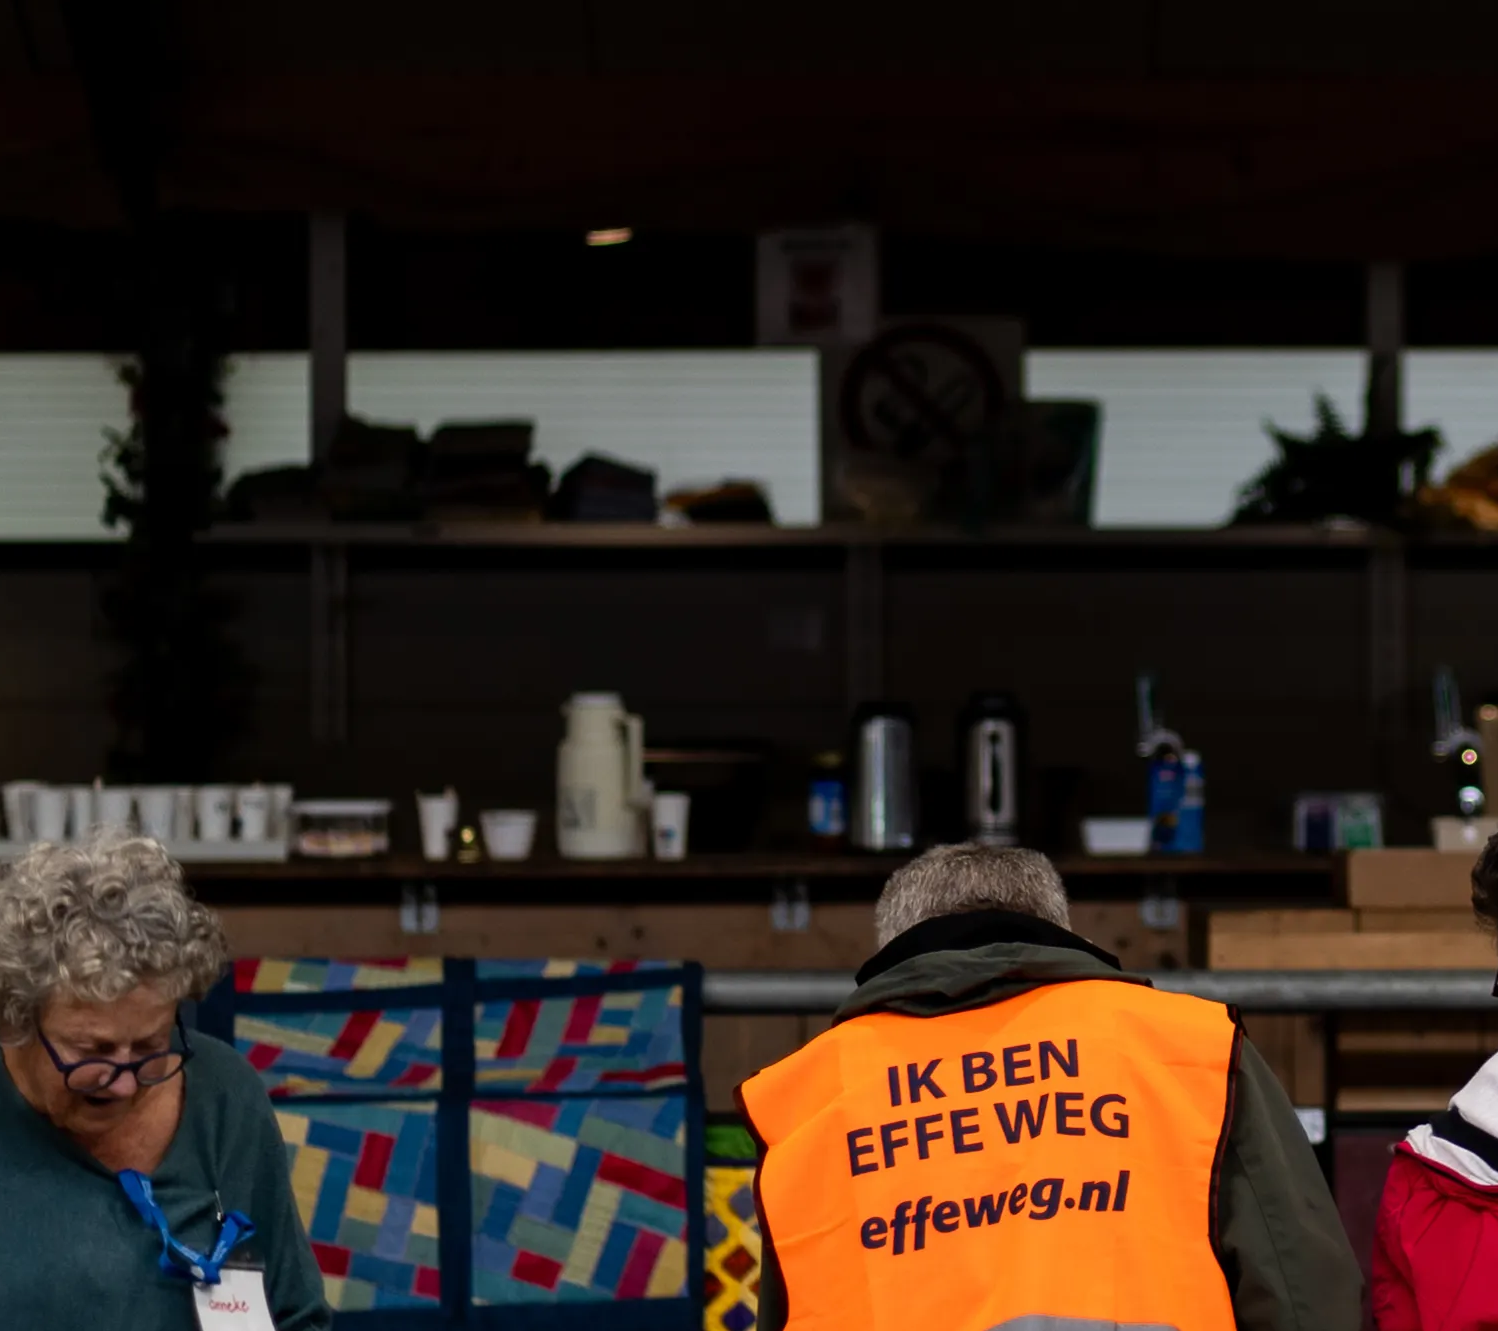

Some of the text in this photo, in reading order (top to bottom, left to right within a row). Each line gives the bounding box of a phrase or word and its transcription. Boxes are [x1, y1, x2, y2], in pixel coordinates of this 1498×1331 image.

[887, 1038, 1080, 1108] IK BEN
[846, 1092, 1130, 1177] EFFE WEG
[860, 1170, 1131, 1256] effeweg.nl
